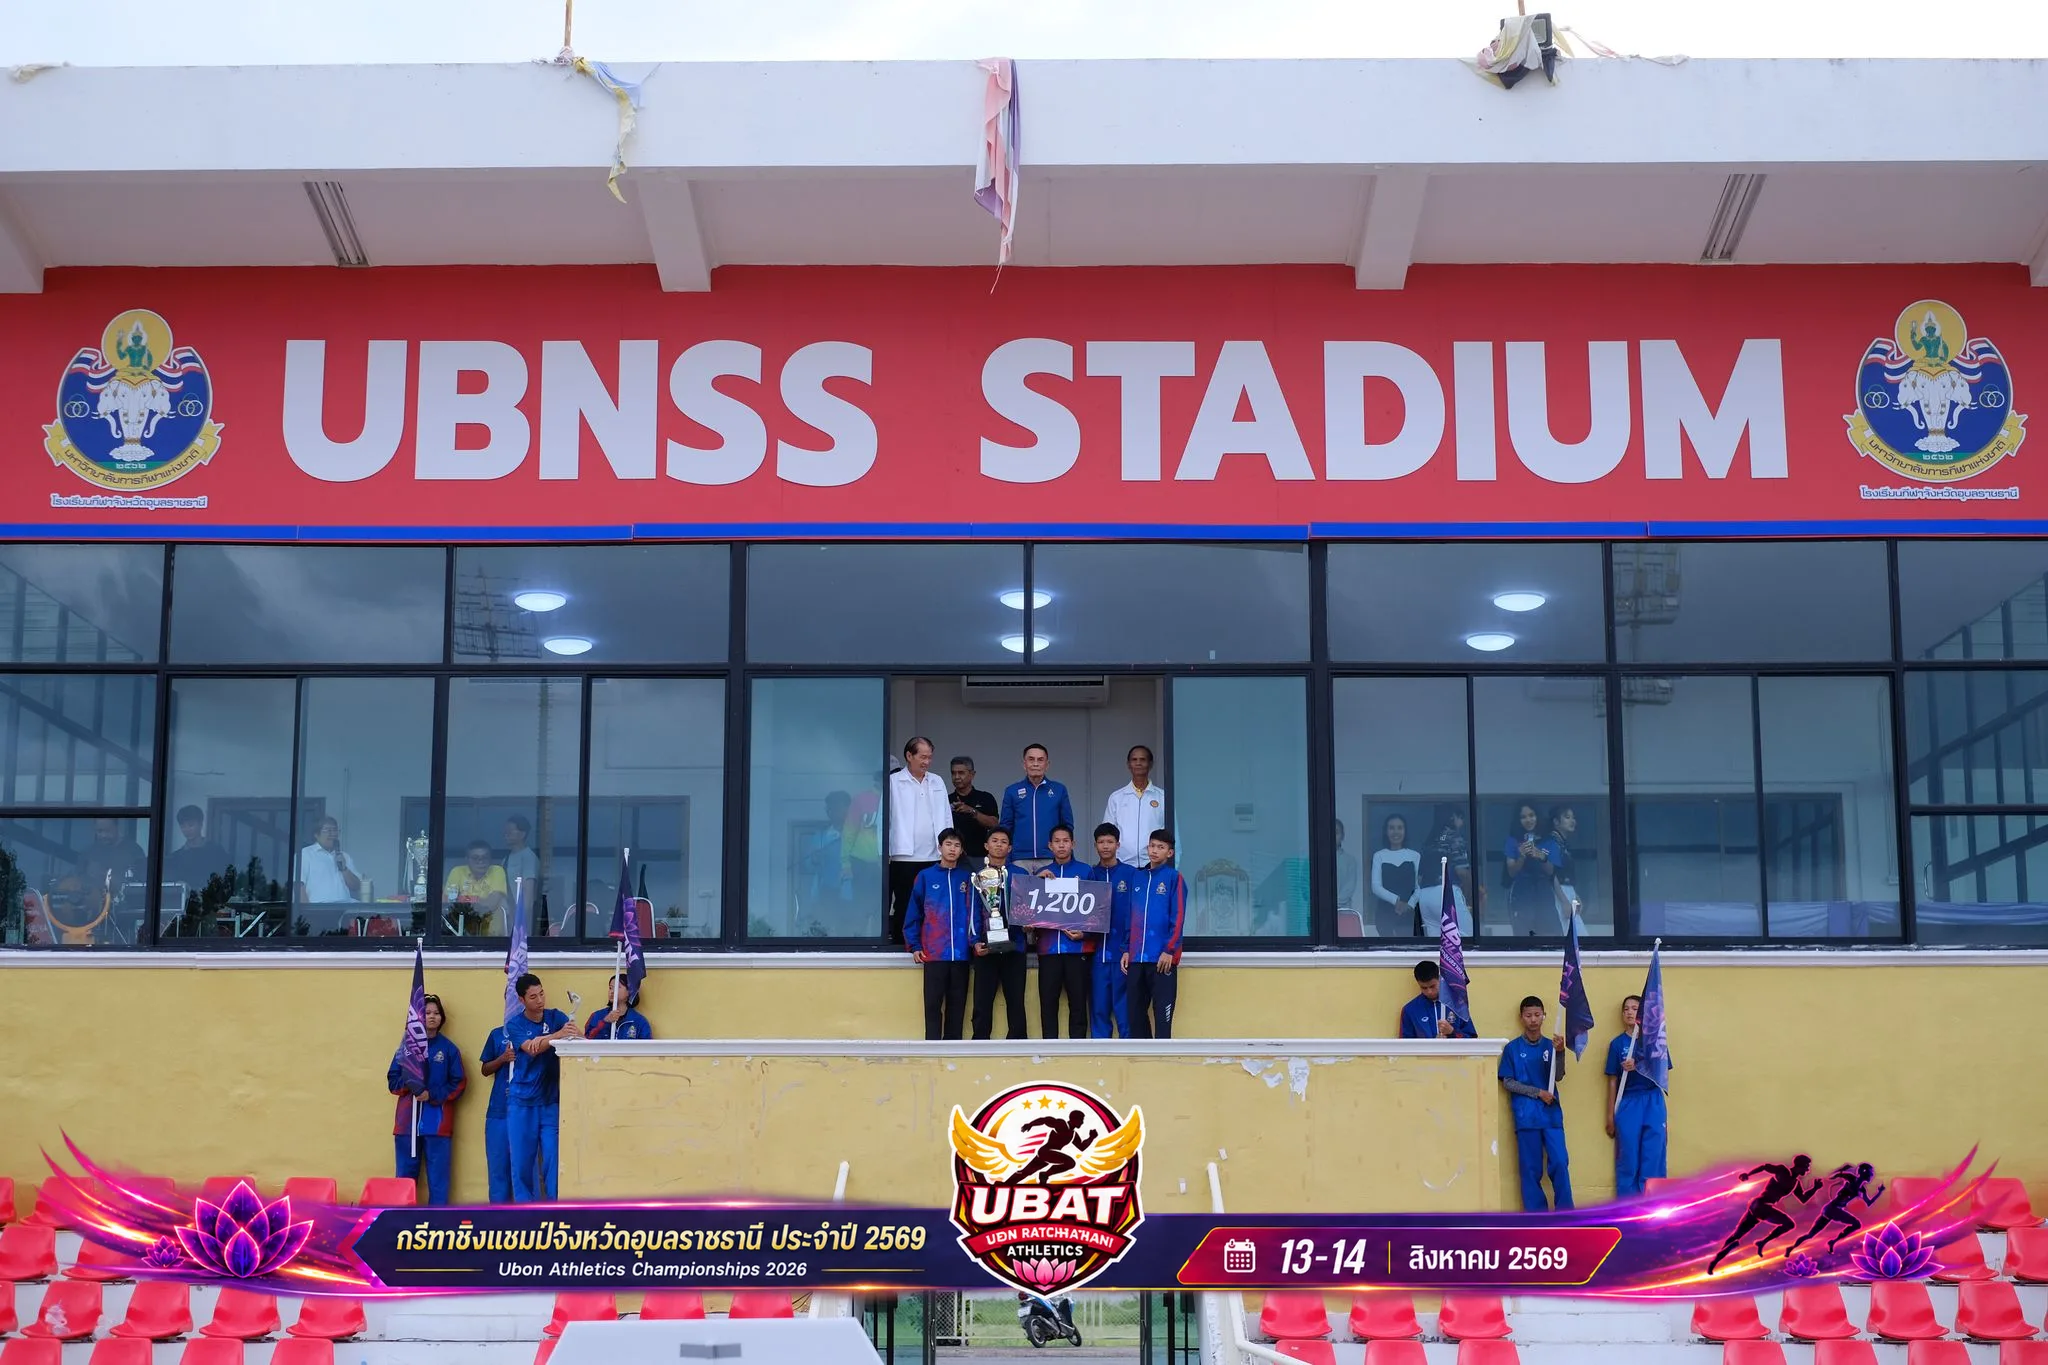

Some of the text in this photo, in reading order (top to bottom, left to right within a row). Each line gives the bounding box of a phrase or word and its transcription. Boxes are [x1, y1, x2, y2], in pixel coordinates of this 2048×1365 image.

[282, 337, 1789, 487] UBNSS STADIUM
[1027, 888, 1096, 916] 1,200
